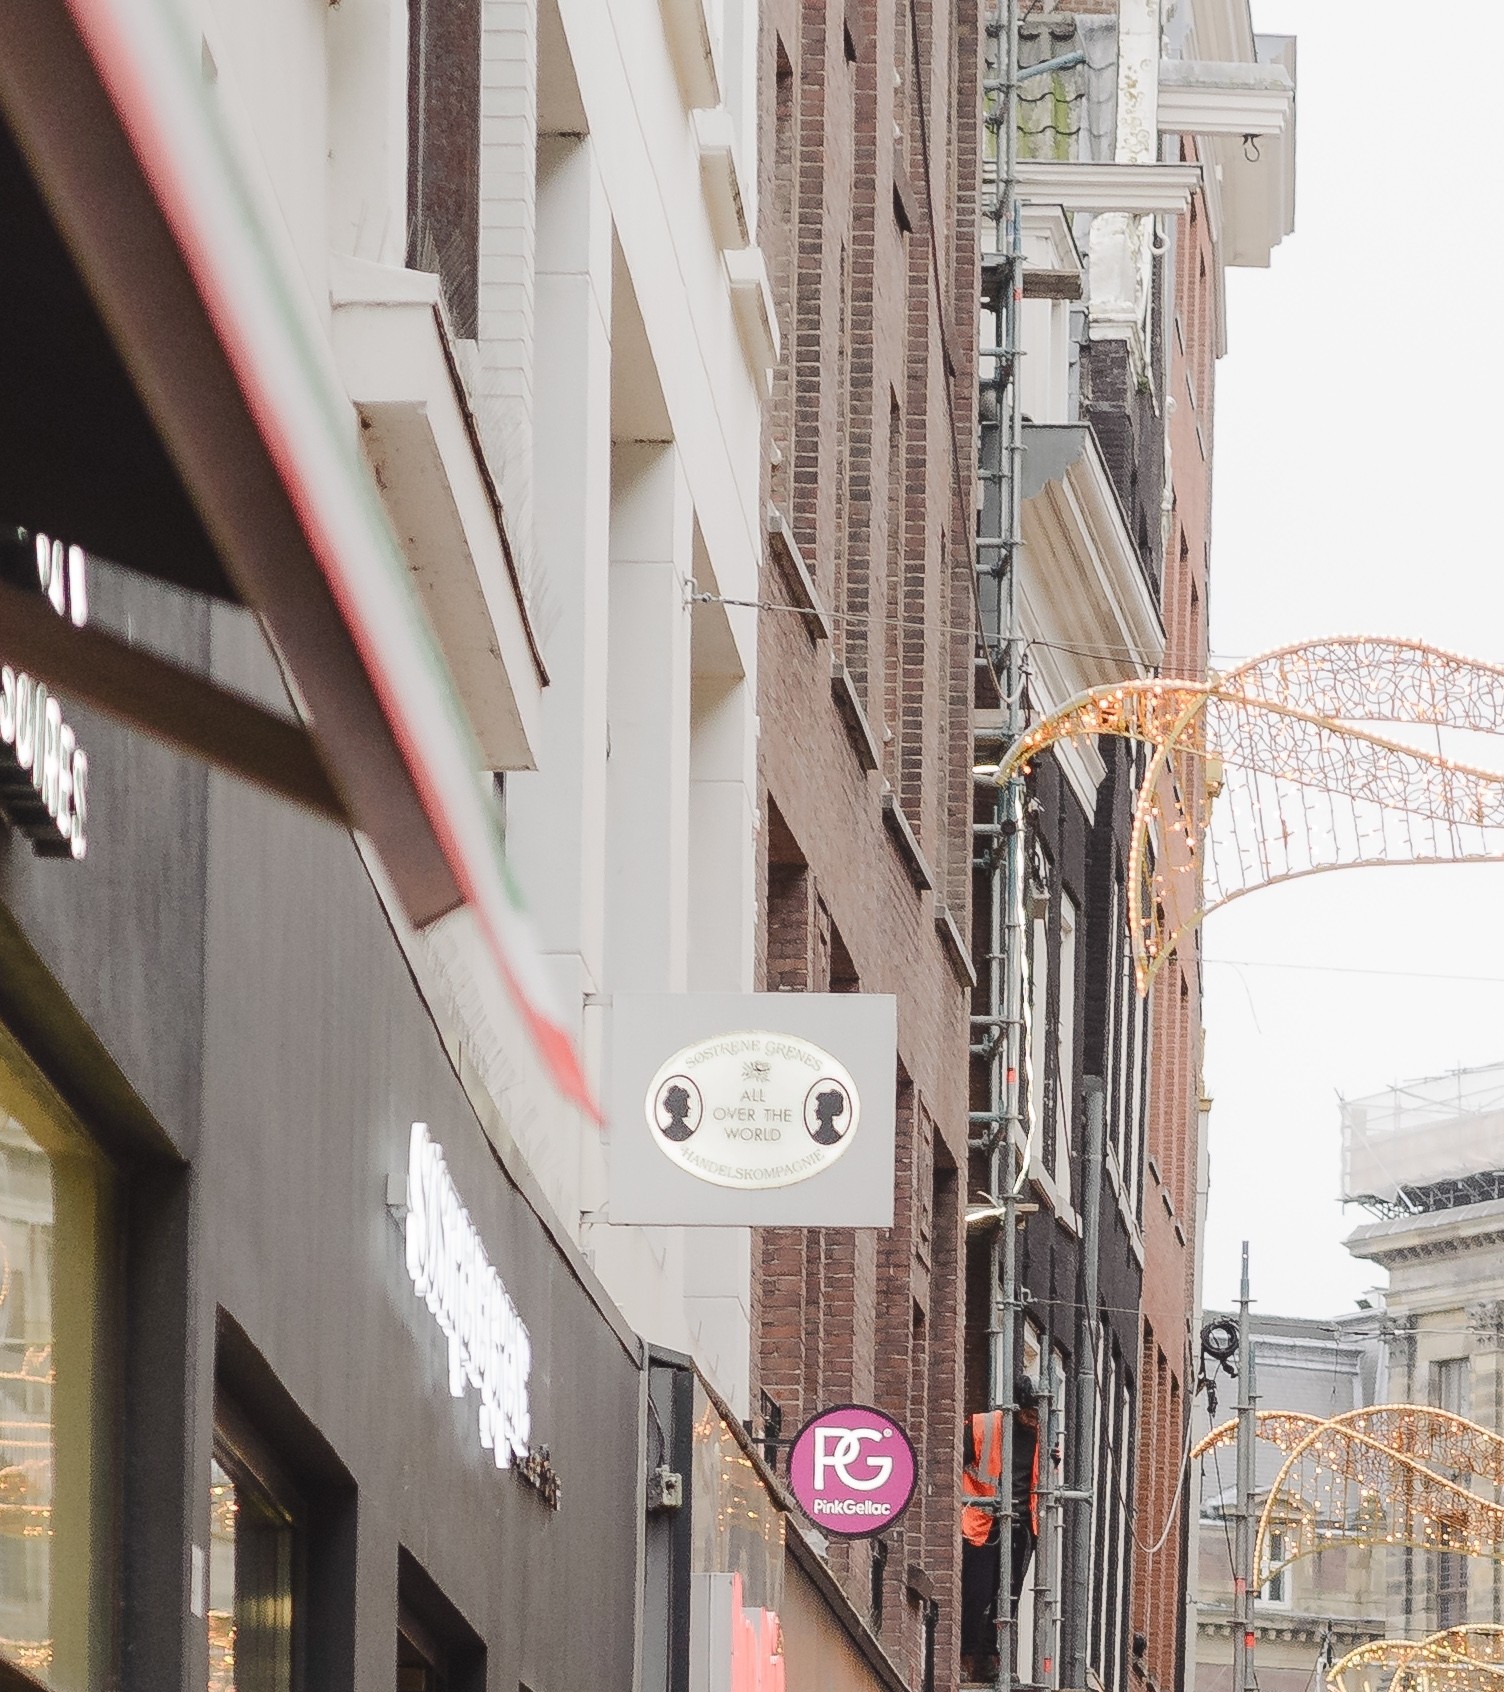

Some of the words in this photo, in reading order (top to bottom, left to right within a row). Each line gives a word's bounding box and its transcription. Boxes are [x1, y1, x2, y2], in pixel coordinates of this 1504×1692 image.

[765, 1040, 824, 1072] GRENES
[740, 1089, 766, 1103] ALL
[712, 1107, 756, 1123] OVER
[764, 1108, 793, 1123] THE
[724, 1127, 782, 1142] WORLD
[813, 1426, 893, 1492] PG
[813, 1498, 892, 1516] PinkGellac
